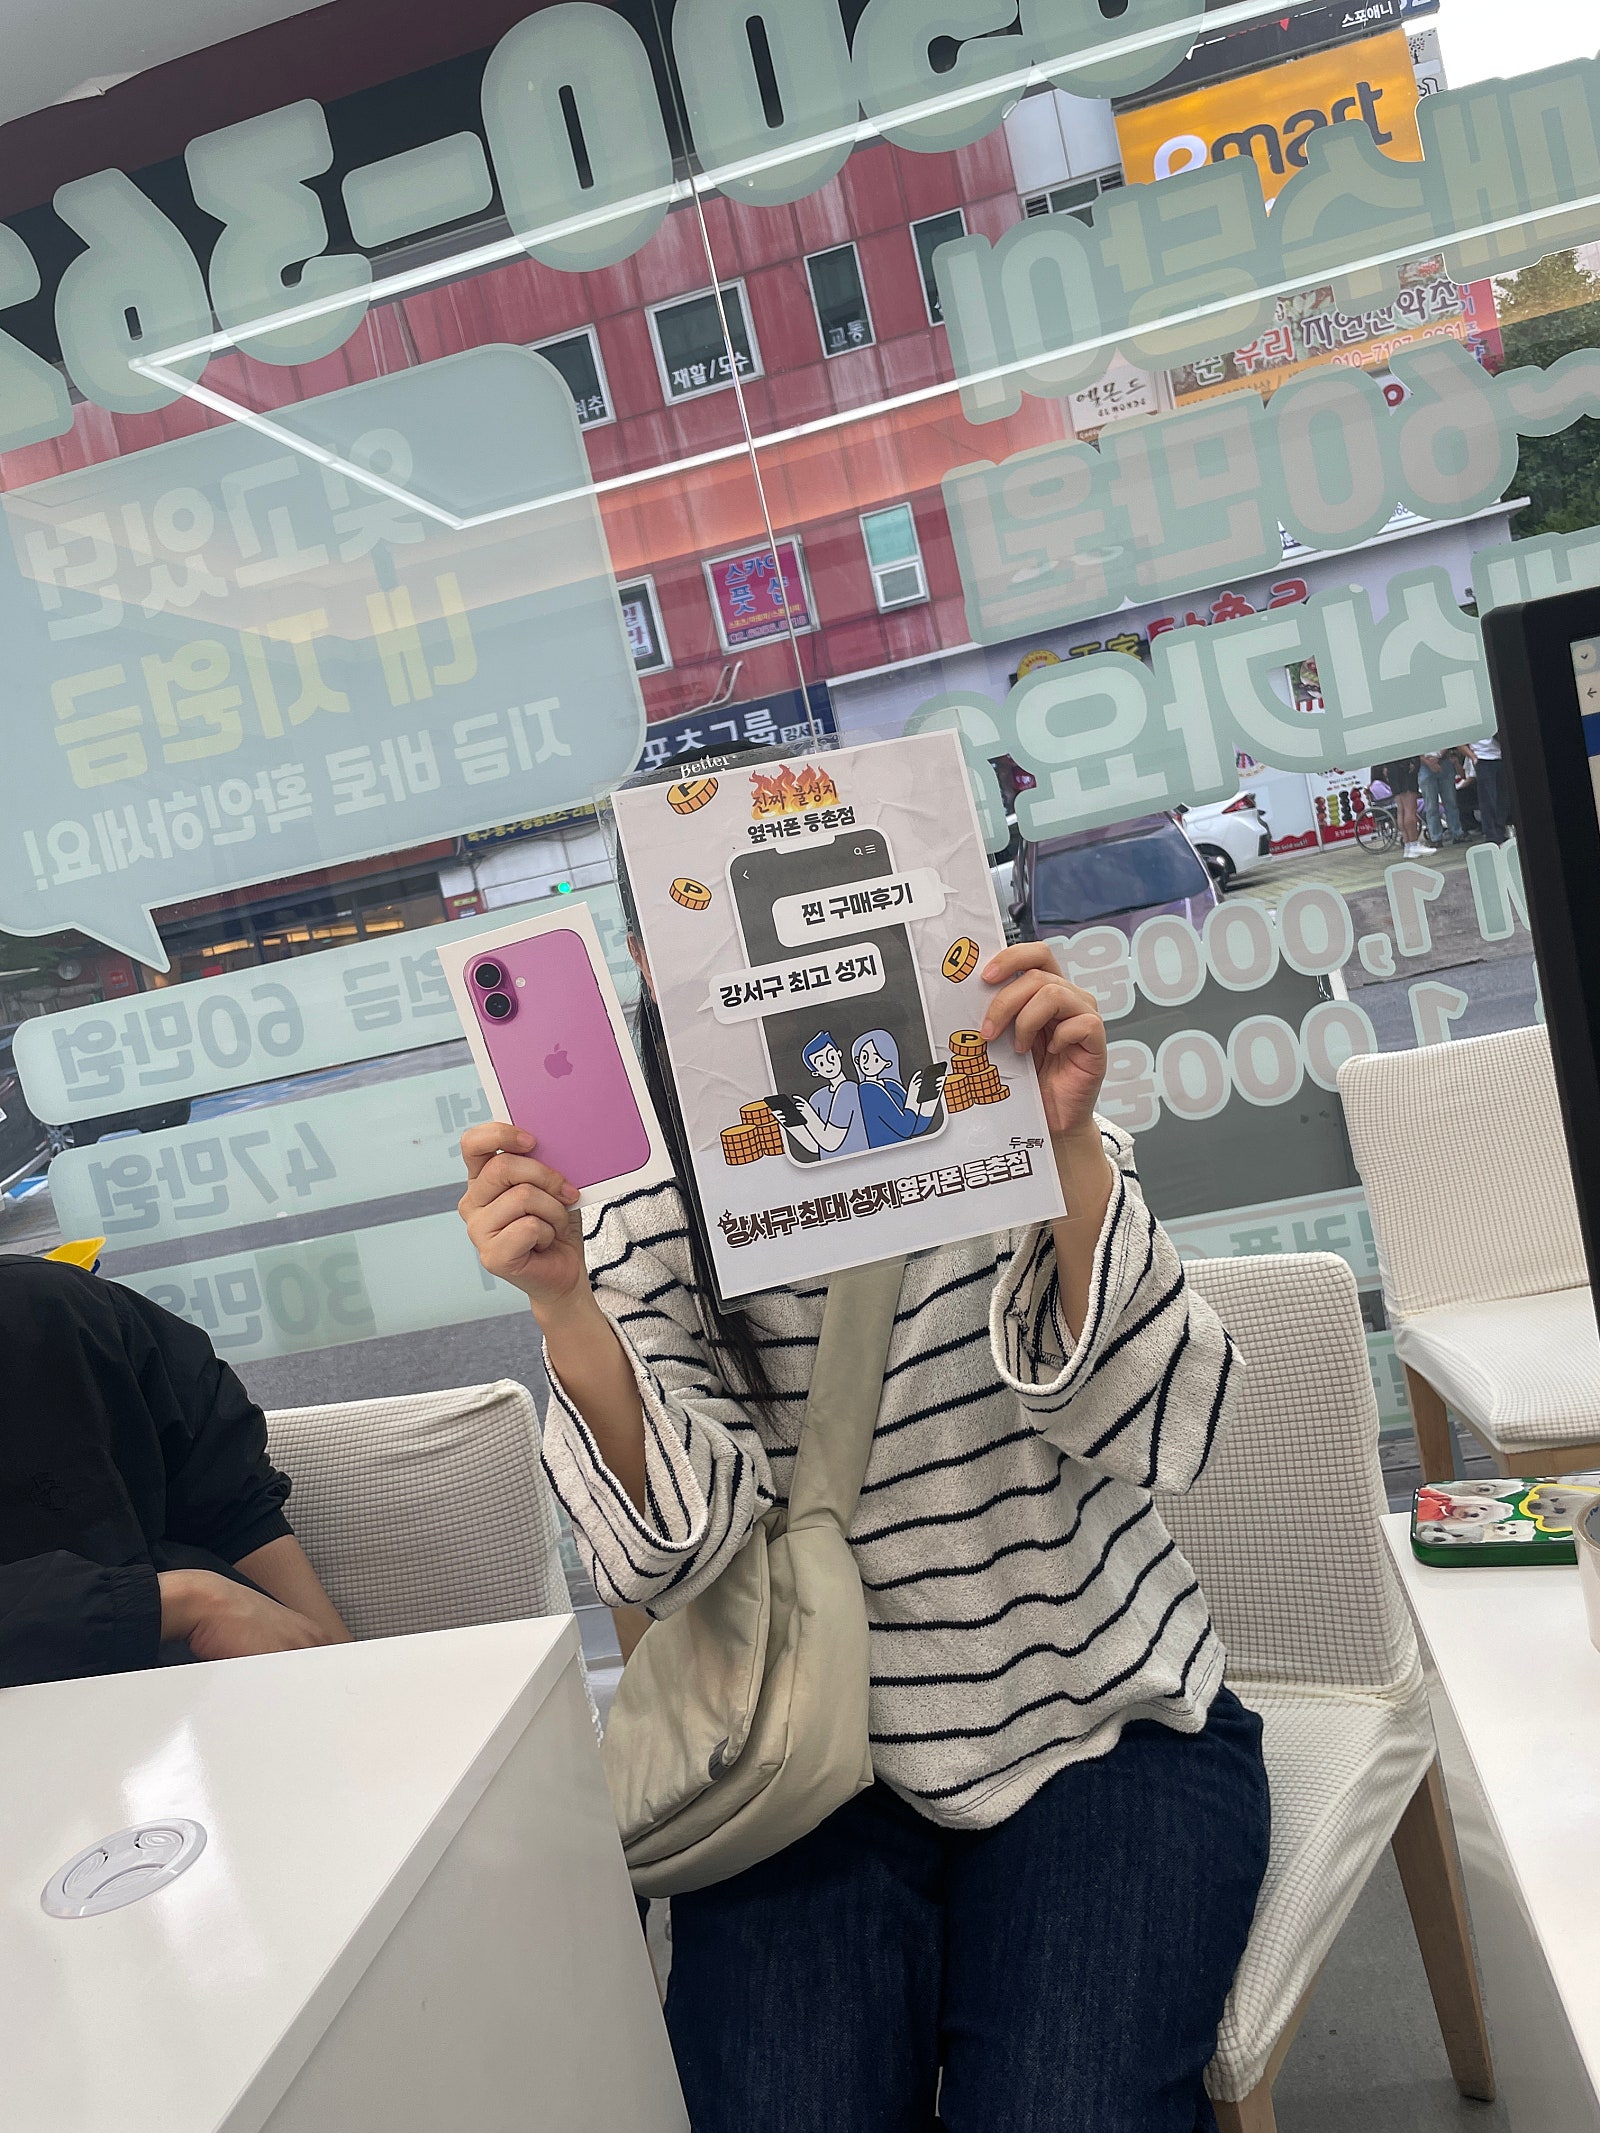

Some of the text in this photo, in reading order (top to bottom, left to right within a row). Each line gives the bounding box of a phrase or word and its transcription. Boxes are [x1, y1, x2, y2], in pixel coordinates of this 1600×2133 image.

[1342, 4, 1393, 28] 스포애니
[829, 320, 865, 348] 교통
[1234, 326, 1296, 373] 우리
[671, 351, 750, 389] 재활/도수
[752, 779, 838, 814] 진짜 불성지
[747, 805, 856, 845] 옆커폰 등촌점
[801, 882, 914, 926] 찐 구매후기
[719, 954, 878, 1008] 강서구 최고 성지
[724, 1203, 800, 1248] 강서구
[797, 1190, 852, 1226] 최대
[962, 1148, 1034, 1189] 등촌점
